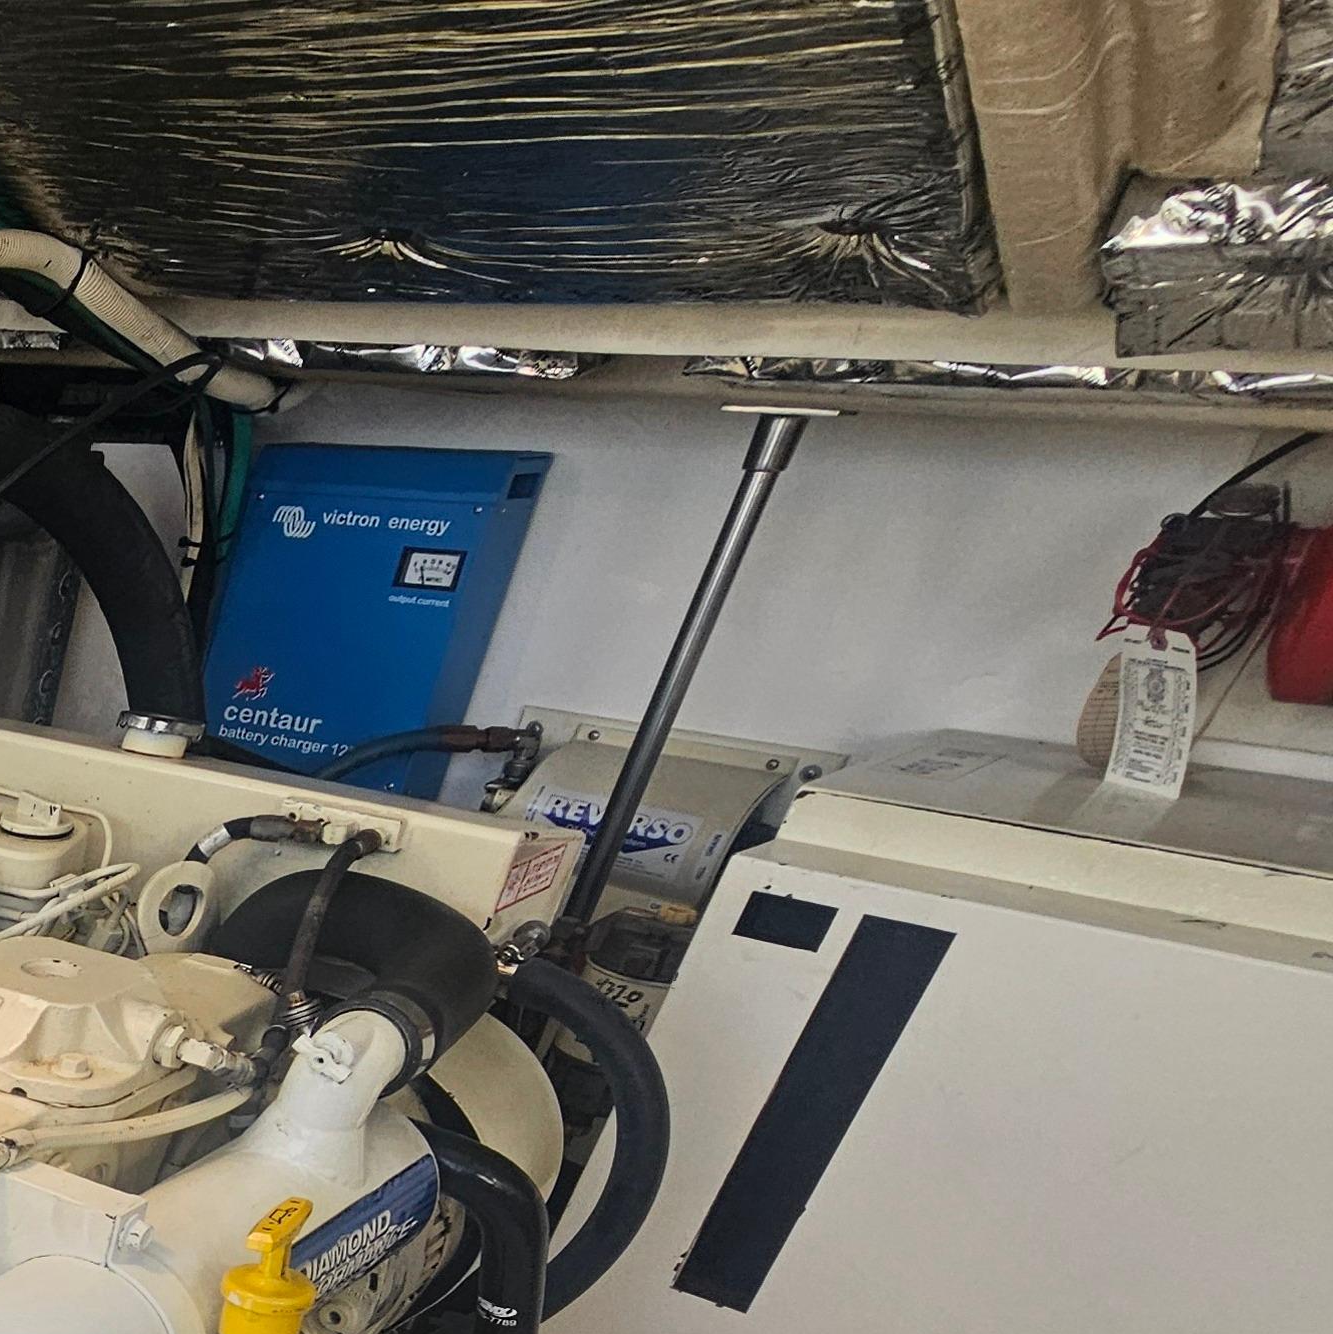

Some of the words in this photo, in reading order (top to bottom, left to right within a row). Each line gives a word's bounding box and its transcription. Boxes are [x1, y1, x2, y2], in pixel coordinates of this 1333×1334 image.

[322, 509, 380, 528] victron
[387, 516, 450, 536] energy
[223, 704, 323, 735] centaur
[218, 725, 268, 747] battery
[271, 732, 329, 757] charger
[545, 795, 693, 844] REVRSO
